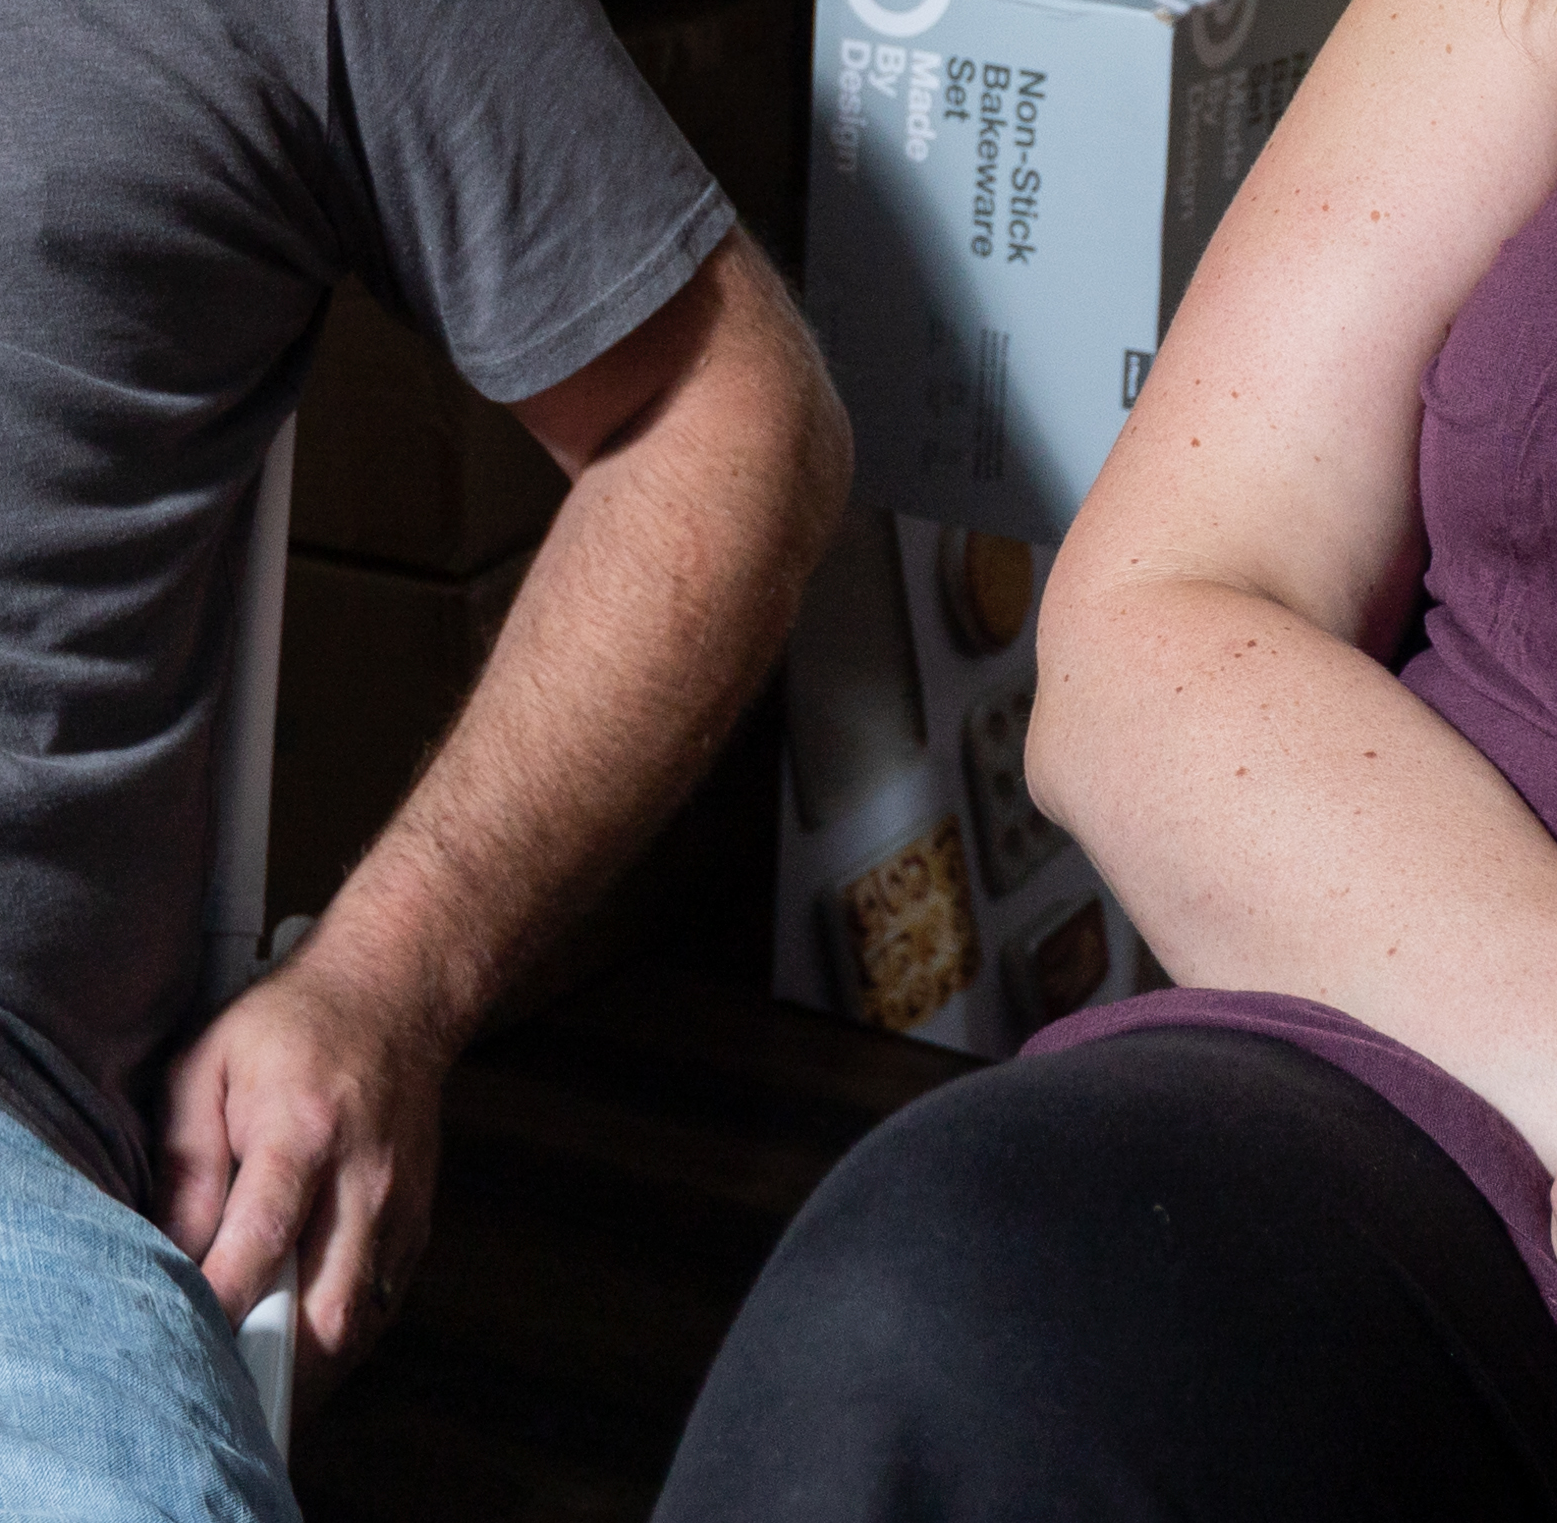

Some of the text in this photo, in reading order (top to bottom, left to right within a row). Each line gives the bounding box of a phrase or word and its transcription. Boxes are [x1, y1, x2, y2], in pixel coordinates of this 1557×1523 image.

[834, 38, 870, 174] Design
[870, 44, 905, 98] By
[907, 50, 942, 162] Made
[945, 56, 975, 123] Set
[972, 63, 1010, 258] Bakeware
[1007, 69, 1048, 264] Non-Stick
